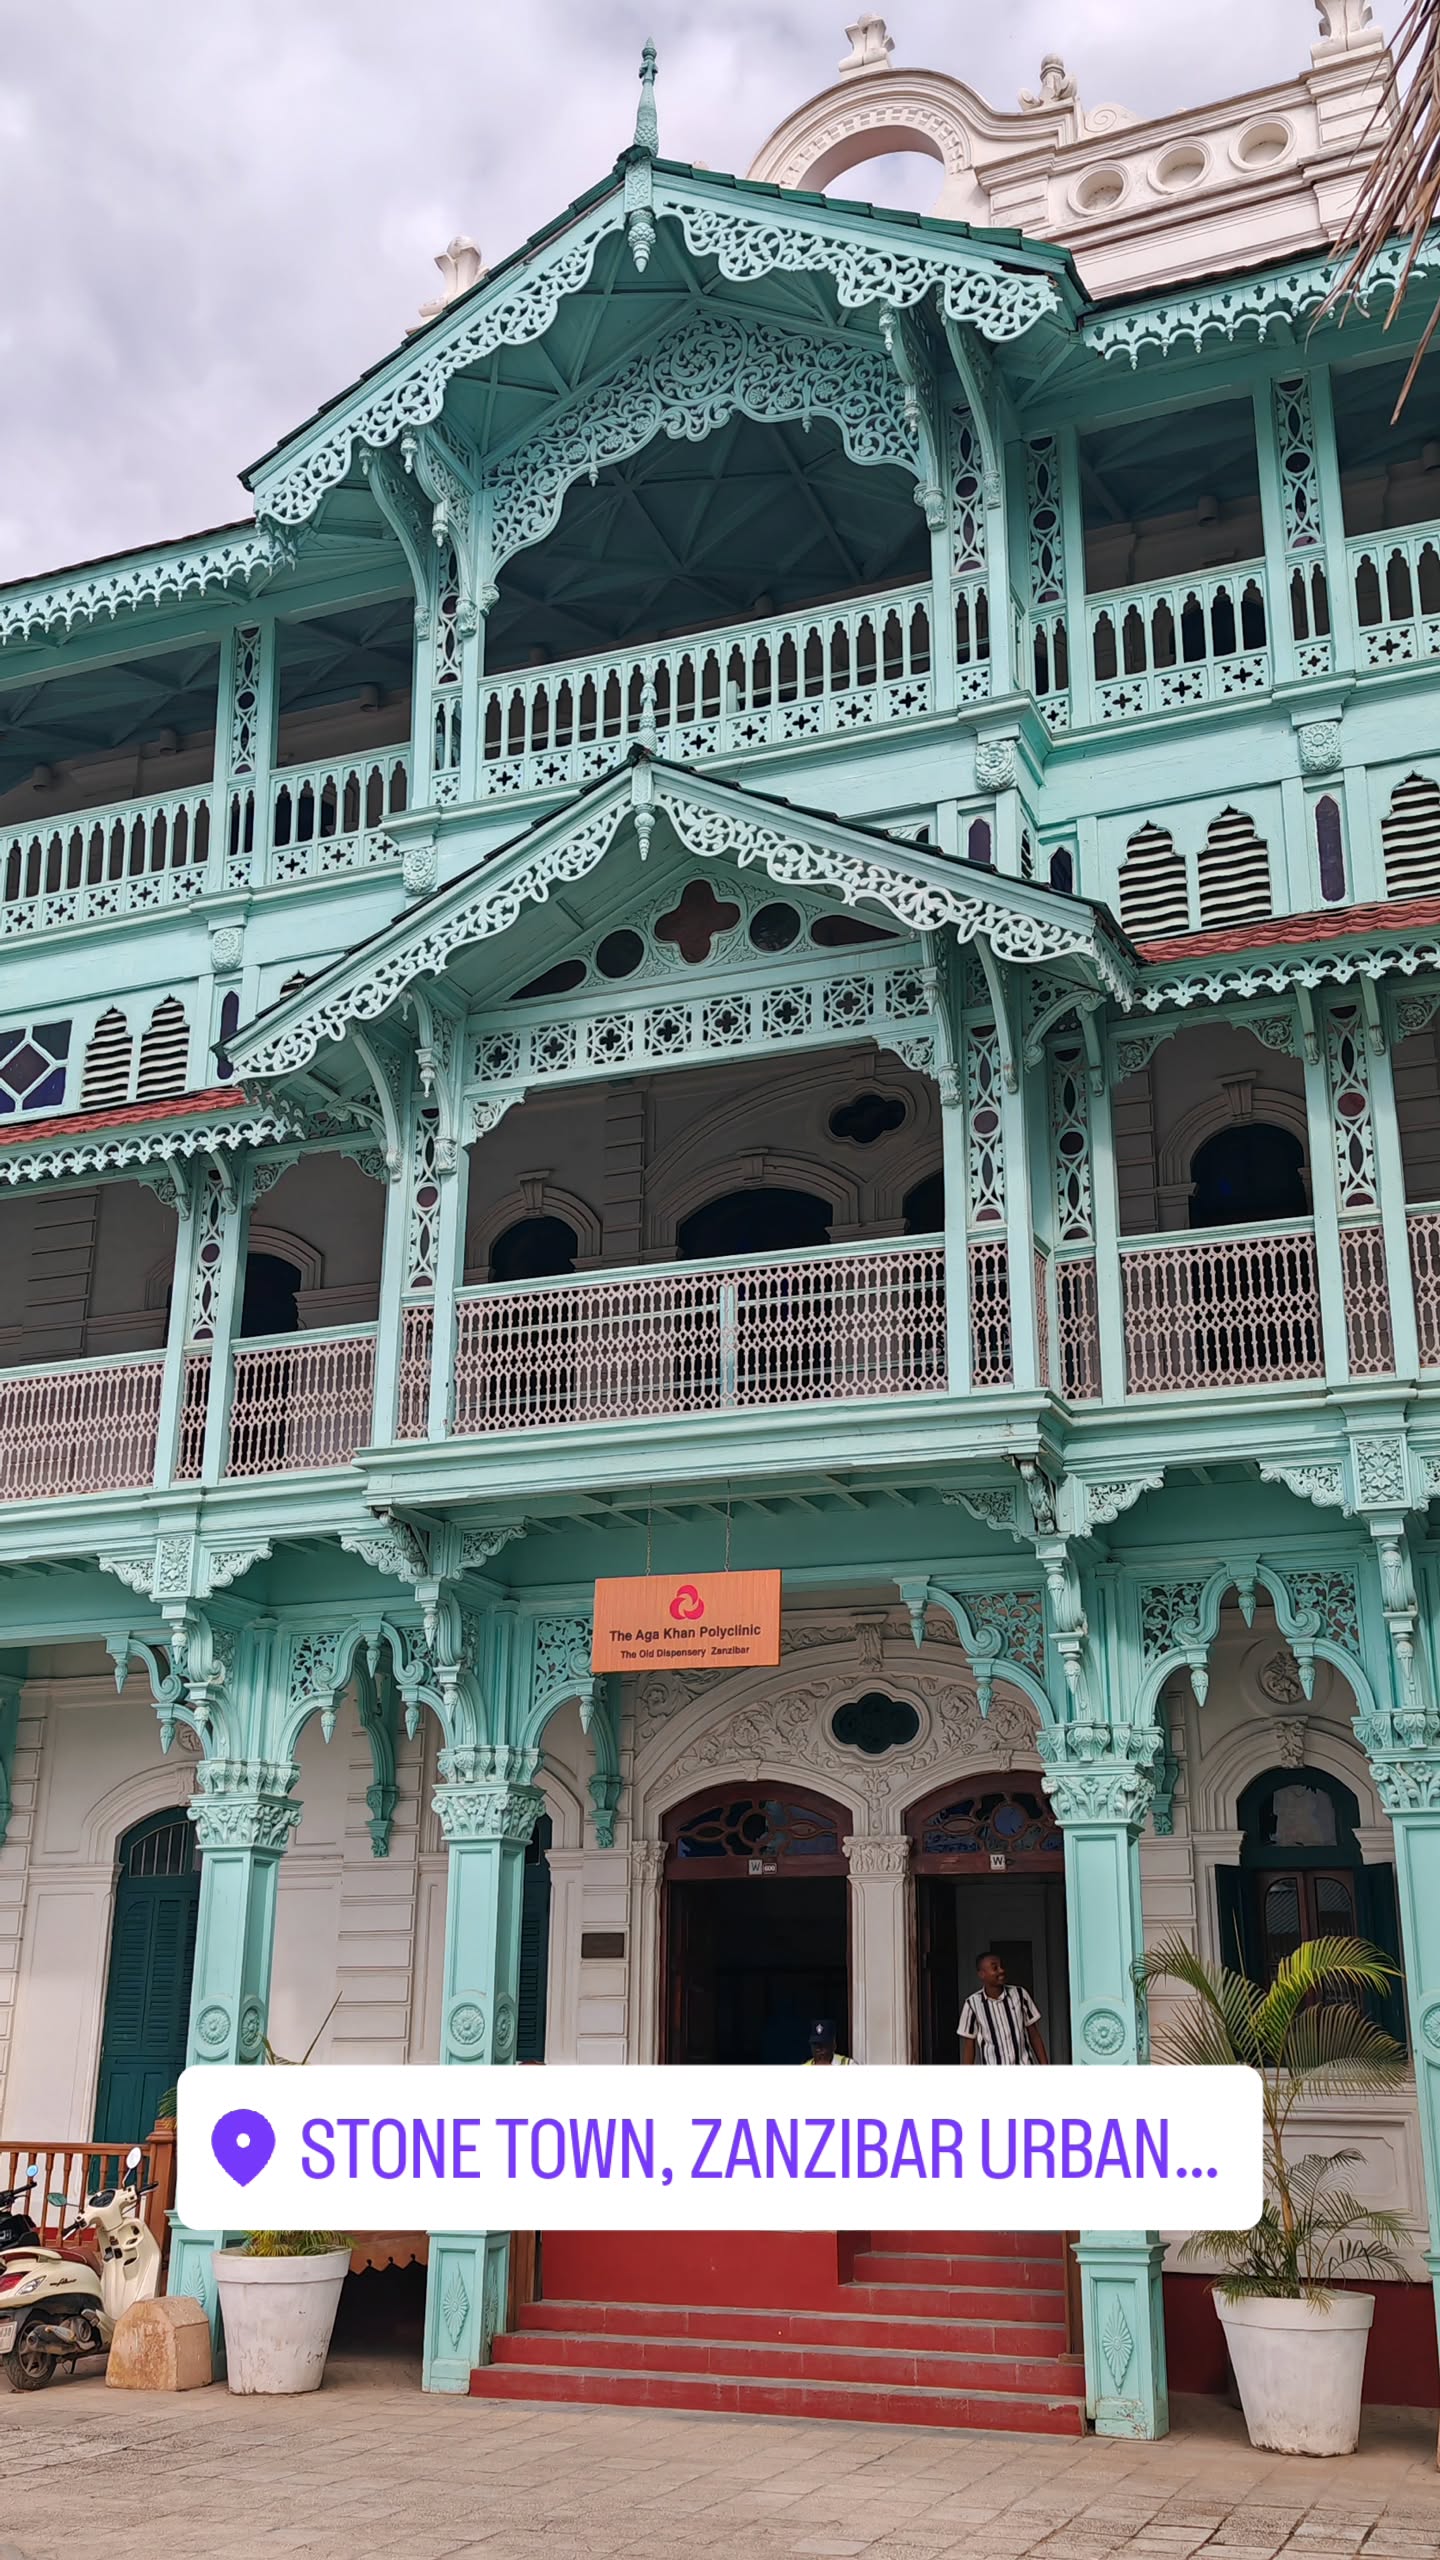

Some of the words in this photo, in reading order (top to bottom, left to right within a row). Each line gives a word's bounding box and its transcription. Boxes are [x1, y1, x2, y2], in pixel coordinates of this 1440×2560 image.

[609, 1630, 632, 1642] The
[636, 1629, 660, 1642] Aga
[663, 1627, 695, 1640] Khan
[699, 1624, 761, 1639] Polyclinic
[621, 1650, 637, 1659] The
[639, 1649, 654, 1659] Old
[711, 1646, 750, 1656] Zanzibar
